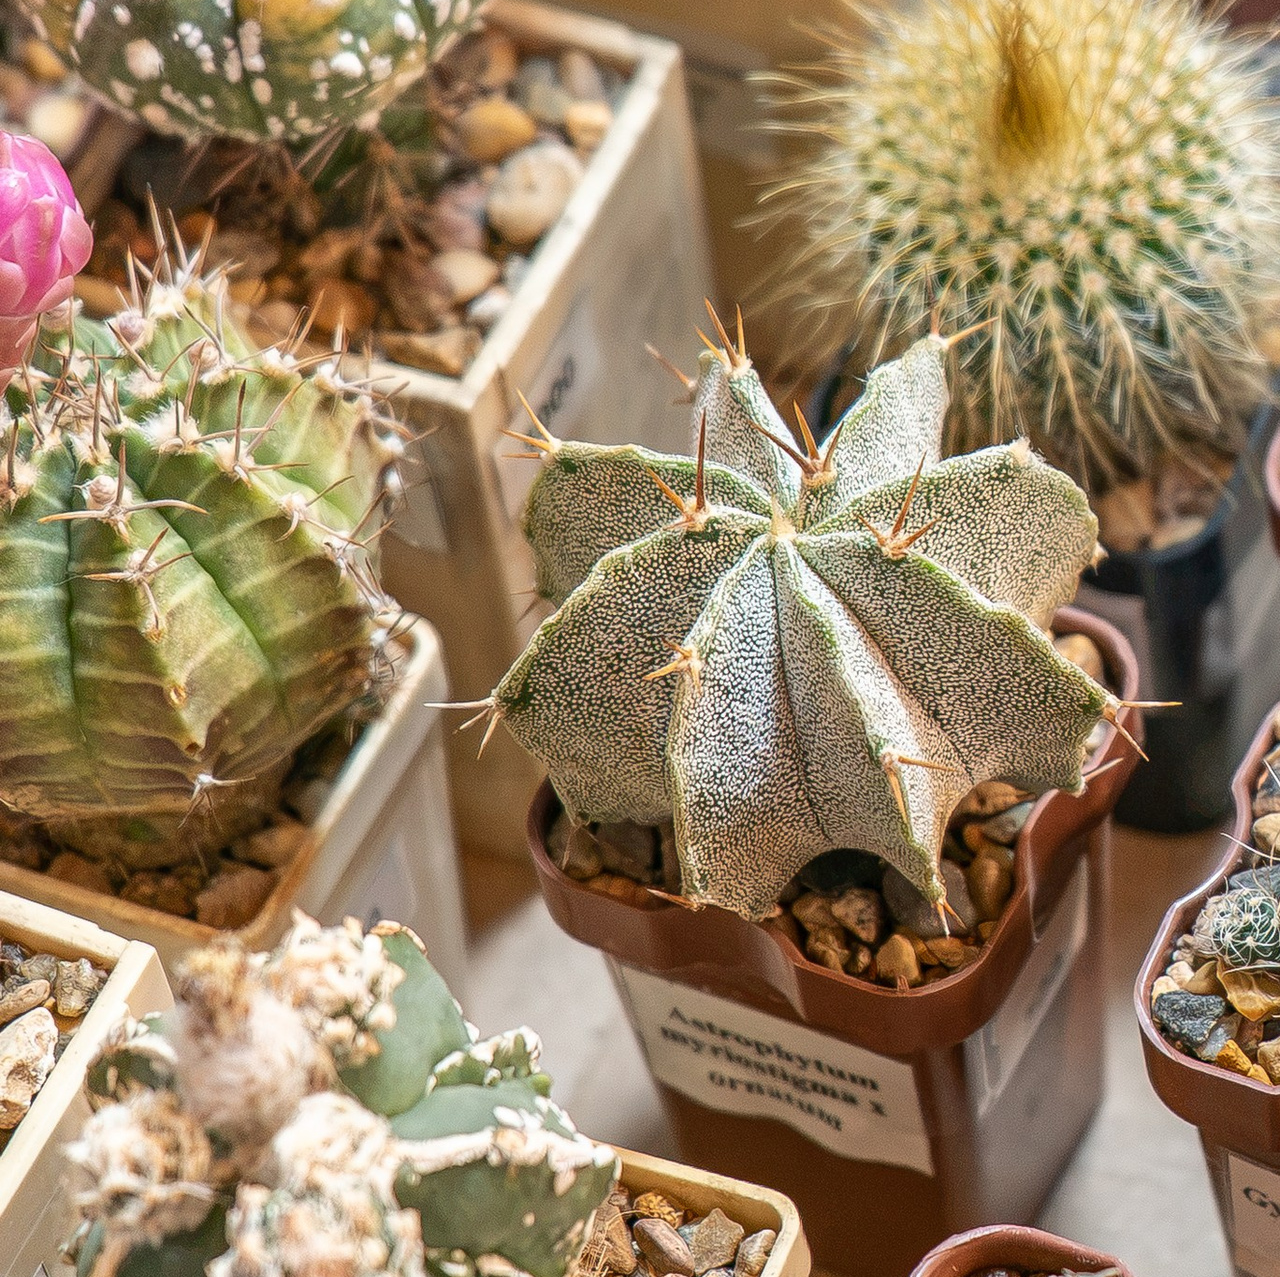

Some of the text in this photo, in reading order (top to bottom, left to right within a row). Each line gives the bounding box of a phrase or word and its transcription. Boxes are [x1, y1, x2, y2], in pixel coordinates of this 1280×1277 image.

[660, 1025, 860, 1107] myriostigma
[669, 1005, 880, 1092] Astrophytum
[708, 1069, 843, 1132] ornatum
